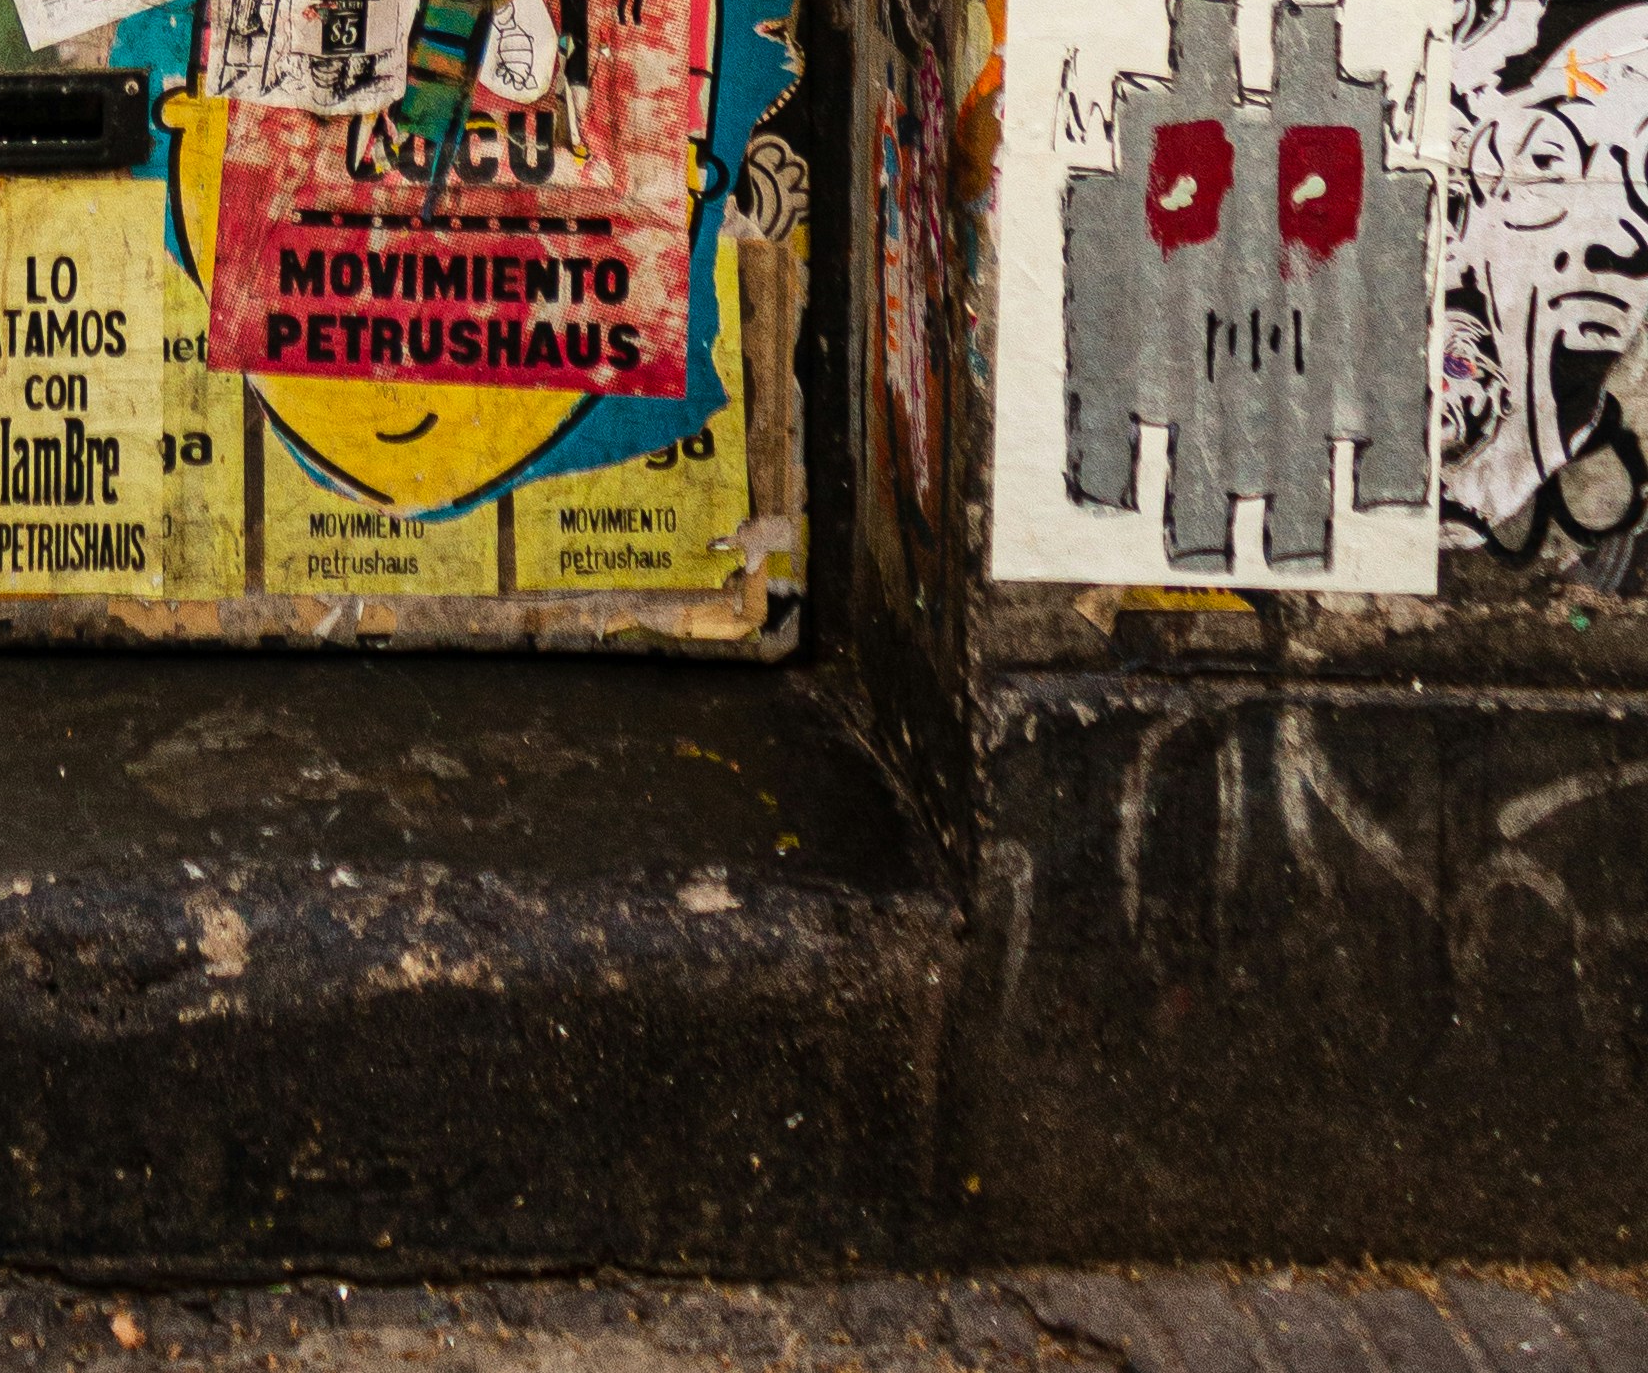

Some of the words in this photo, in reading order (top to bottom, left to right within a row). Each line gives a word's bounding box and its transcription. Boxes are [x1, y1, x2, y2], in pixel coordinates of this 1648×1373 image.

[330, 18, 359, 45] $5
[26, 256, 77, 305] LO
[279, 248, 629, 304] MOVIMIENTO
[267, 312, 639, 370] PETRUSHAUS
[24, 372, 88, 412] con
[309, 511, 425, 539] MOVIMIENTO
[560, 506, 677, 535] MOVIMIENTO
[308, 550, 419, 579] petrushaus
[560, 546, 672, 576] petrushaus
